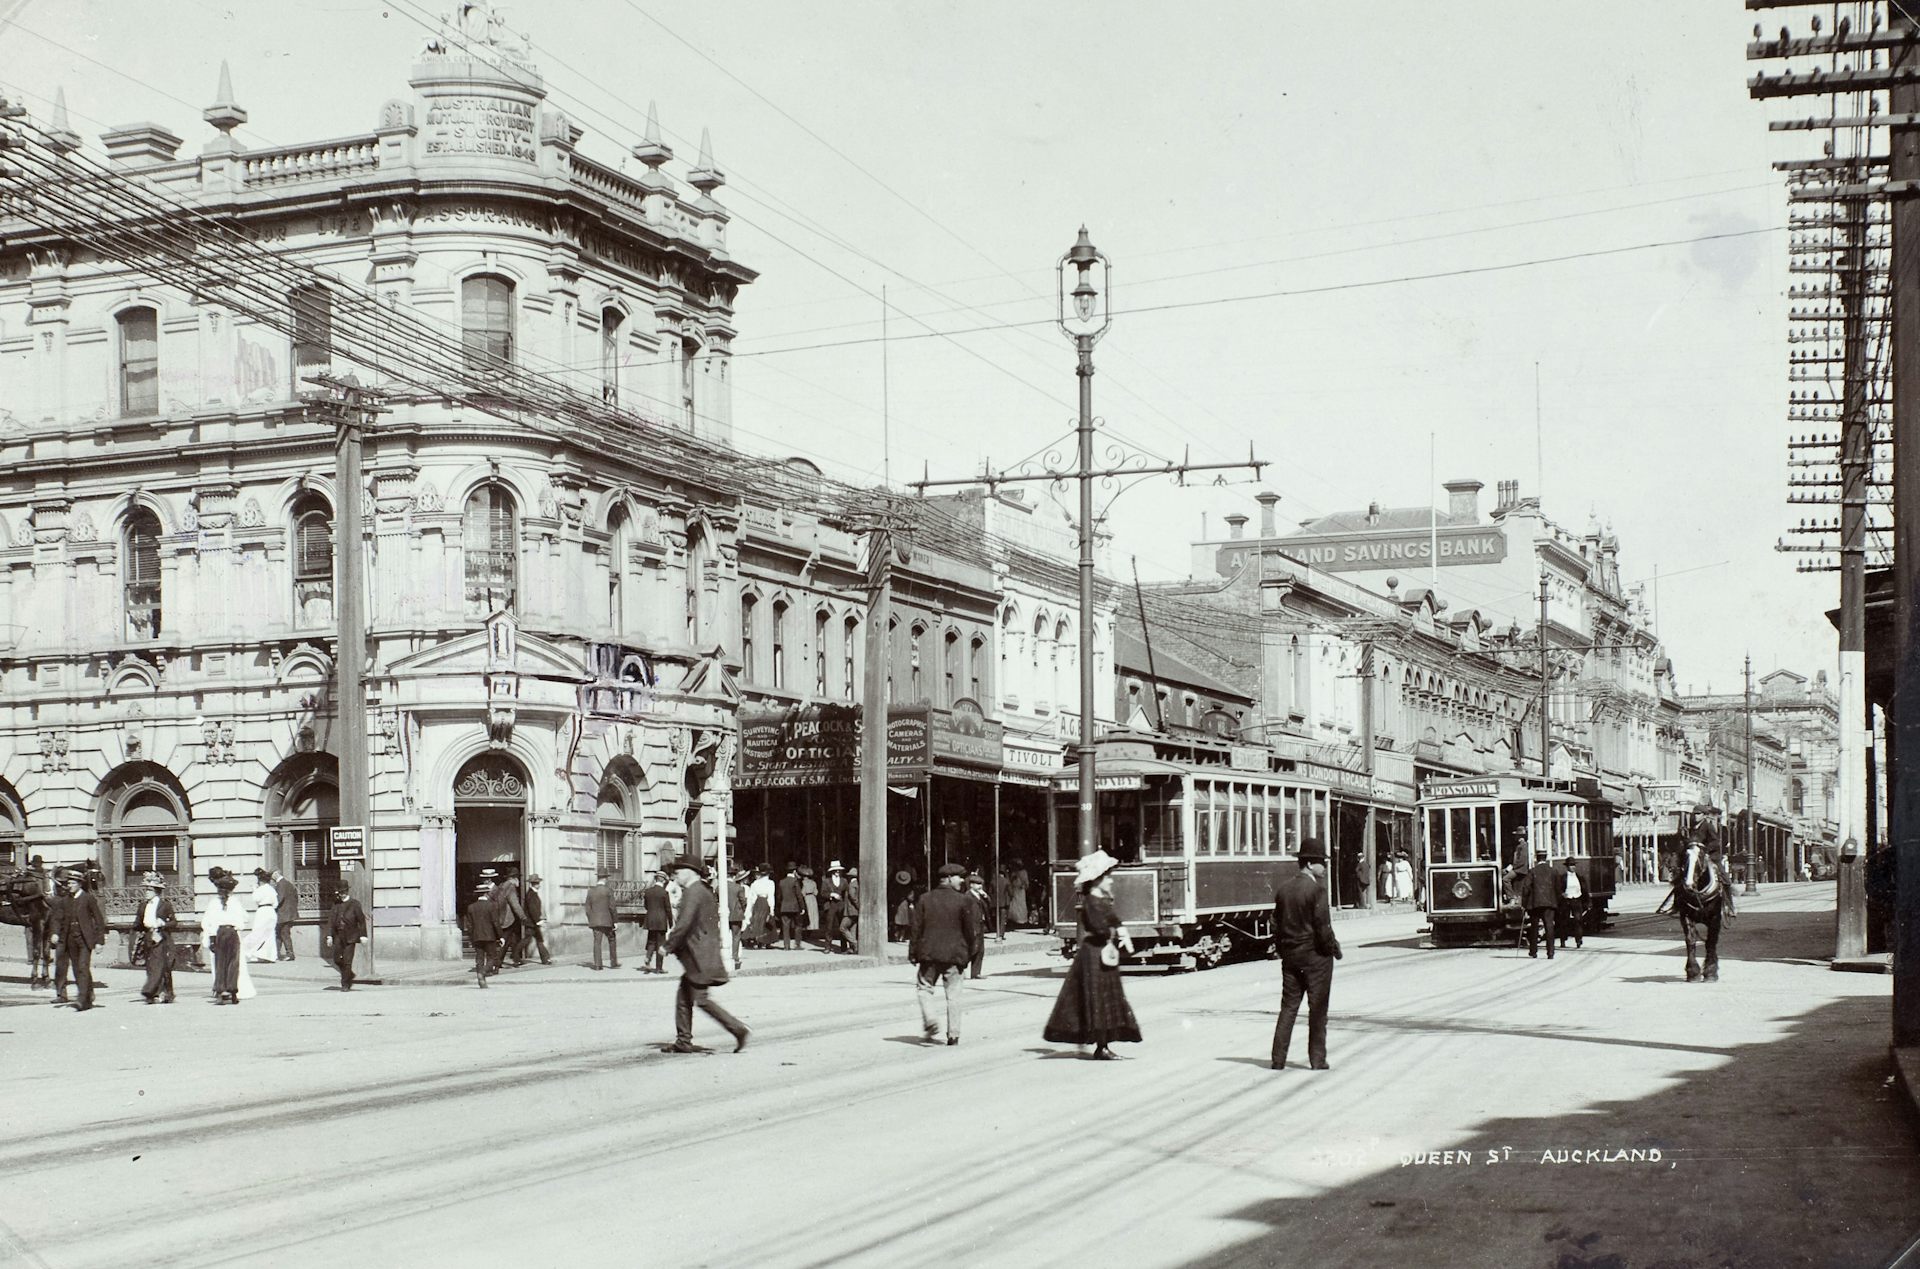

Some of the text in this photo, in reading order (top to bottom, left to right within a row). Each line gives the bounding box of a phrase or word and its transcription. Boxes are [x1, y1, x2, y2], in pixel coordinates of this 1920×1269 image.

[430, 98, 531, 119] AUSTRALIAN
[426, 113, 535, 133] MUTUAL PROVIDENT
[454, 127, 520, 143] SOCIETY
[423, 205, 542, 231] ASSURANCE
[317, 213, 362, 237] LIFE
[1343, 542, 1431, 562] SAVINGS
[1440, 538, 1496, 557] BANK
[793, 720, 844, 740] PEACOCK
[887, 719, 927, 730] HOTOGRAPHIC
[742, 725, 780, 738] SURVEYING
[889, 730, 924, 738] CAMERAS
[746, 738, 778, 747] NAUTICAL
[887, 740, 926, 751] MATERIALS
[952, 739, 983, 757] OPTICIANS
[785, 746, 862, 760] OPTICIAN
[1009, 750, 1053, 766] TIVOLI
[757, 761, 789, 770] SIGHT
[792, 758, 837, 769] TESTING
[755, 776, 796, 786] PEACOCK
[838, 774, 862, 784] ENGLA
[1309, 766, 1338, 784] LONDON
[1065, 777, 1132, 789] POSONBY
[1433, 784, 1489, 796] PONSONBY
[334, 831, 362, 840] CAUTION
[1457, 871, 1470, 880] 14
